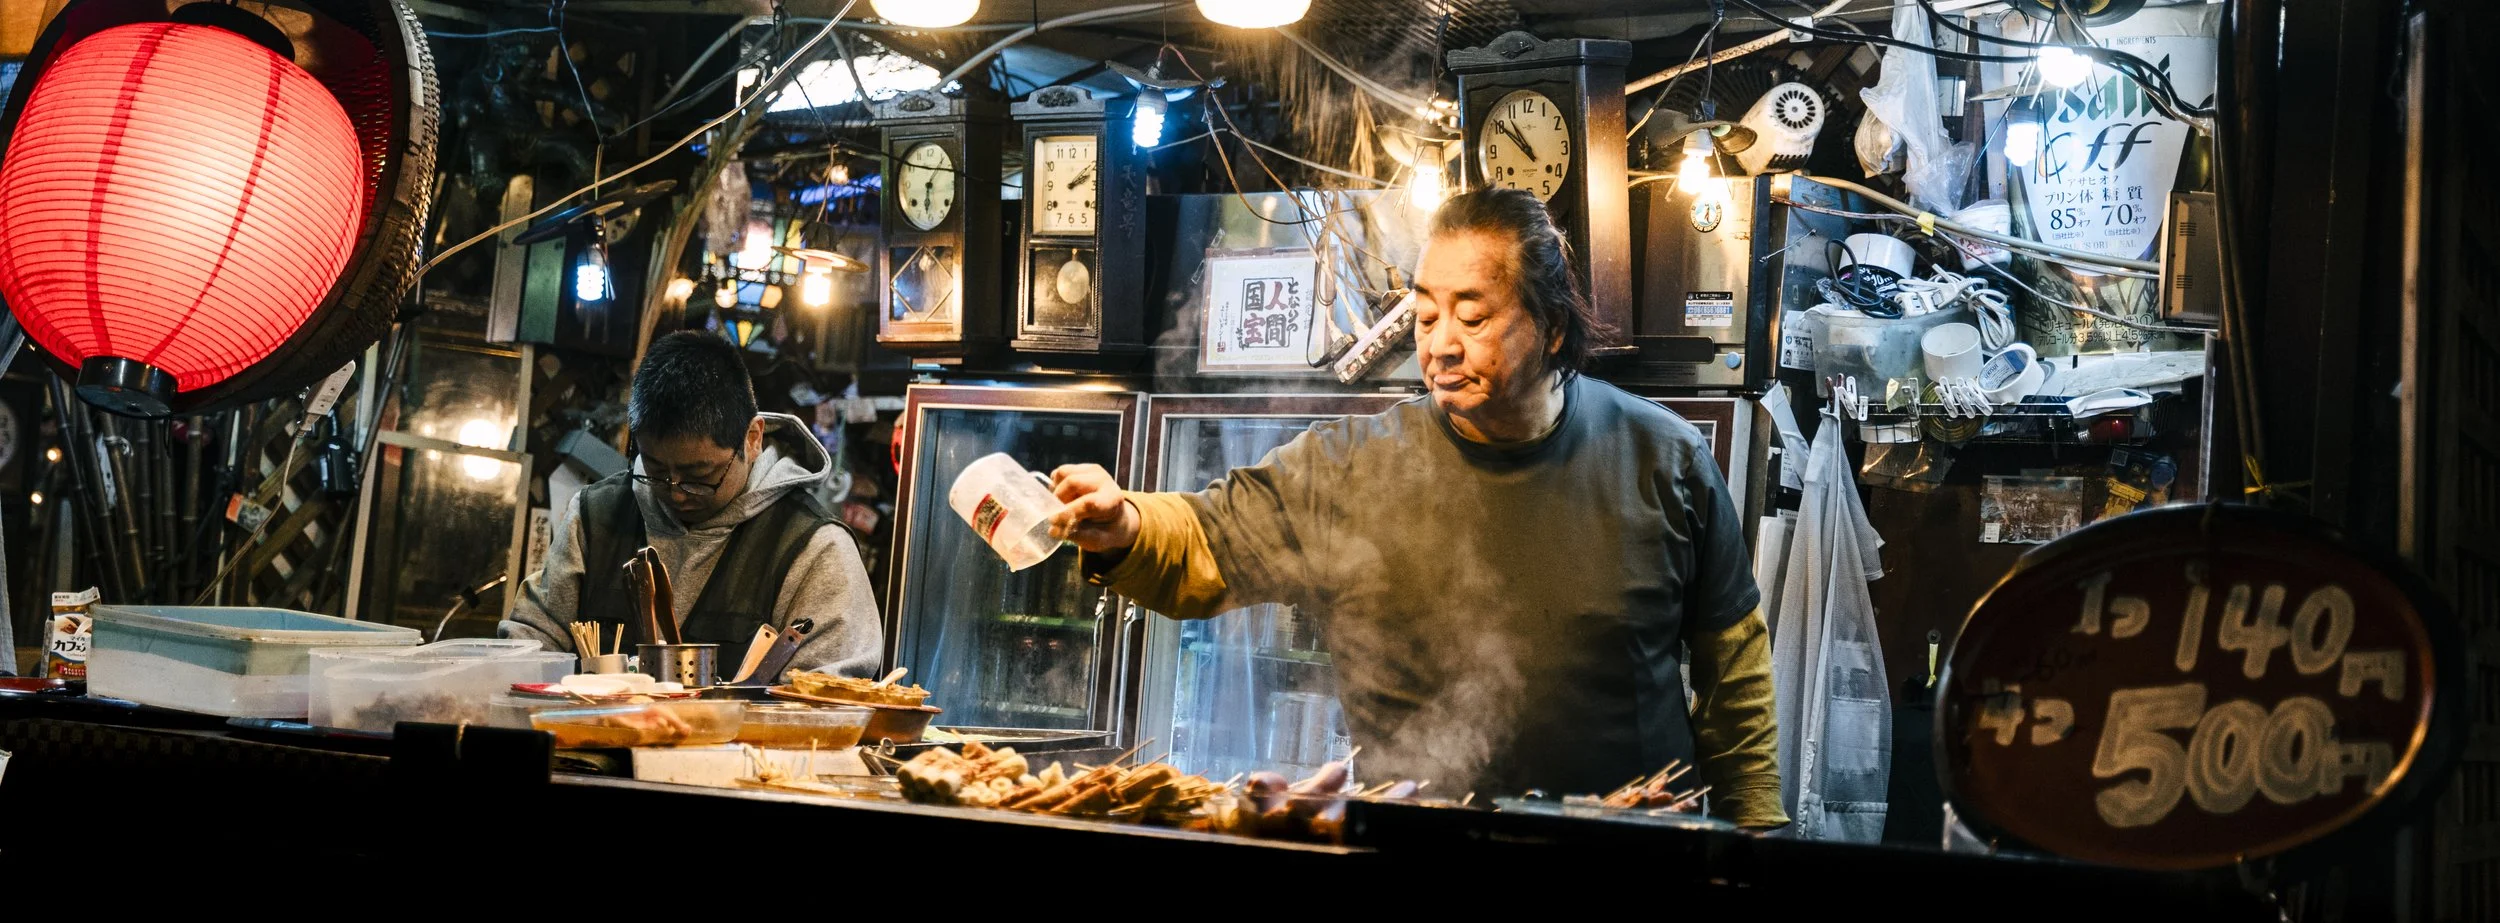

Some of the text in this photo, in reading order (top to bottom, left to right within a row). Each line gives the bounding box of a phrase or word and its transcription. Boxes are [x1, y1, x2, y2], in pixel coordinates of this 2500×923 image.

[1508, 104, 1516, 119] 11
[1523, 99, 1534, 113] 12
[1495, 120, 1505, 135] 10
[1554, 116, 1562, 131] 2
[1056, 148, 1064, 159] 11
[1069, 148, 1077, 159] 12
[1490, 144, 1497, 159] 9
[1561, 140, 1569, 156] 3
[1091, 160, 1097, 171] 2
[1554, 163, 1563, 178] 4
[1495, 166, 1503, 181] 8
[1047, 181, 1054, 191] 9
[1091, 181, 1097, 191] 3
[1542, 180, 1550, 195] 5
[2045, 189, 2093, 206] プリン体
[1046, 201, 1053, 211] 8
[1056, 213, 1062, 223] 7
[1068, 213, 1075, 224] 6
[1080, 213, 1087, 224] 5
[1243, 280, 1266, 345] 国宝
[1264, 281, 1289, 347] 人間
[1286, 281, 1300, 332] となりの
